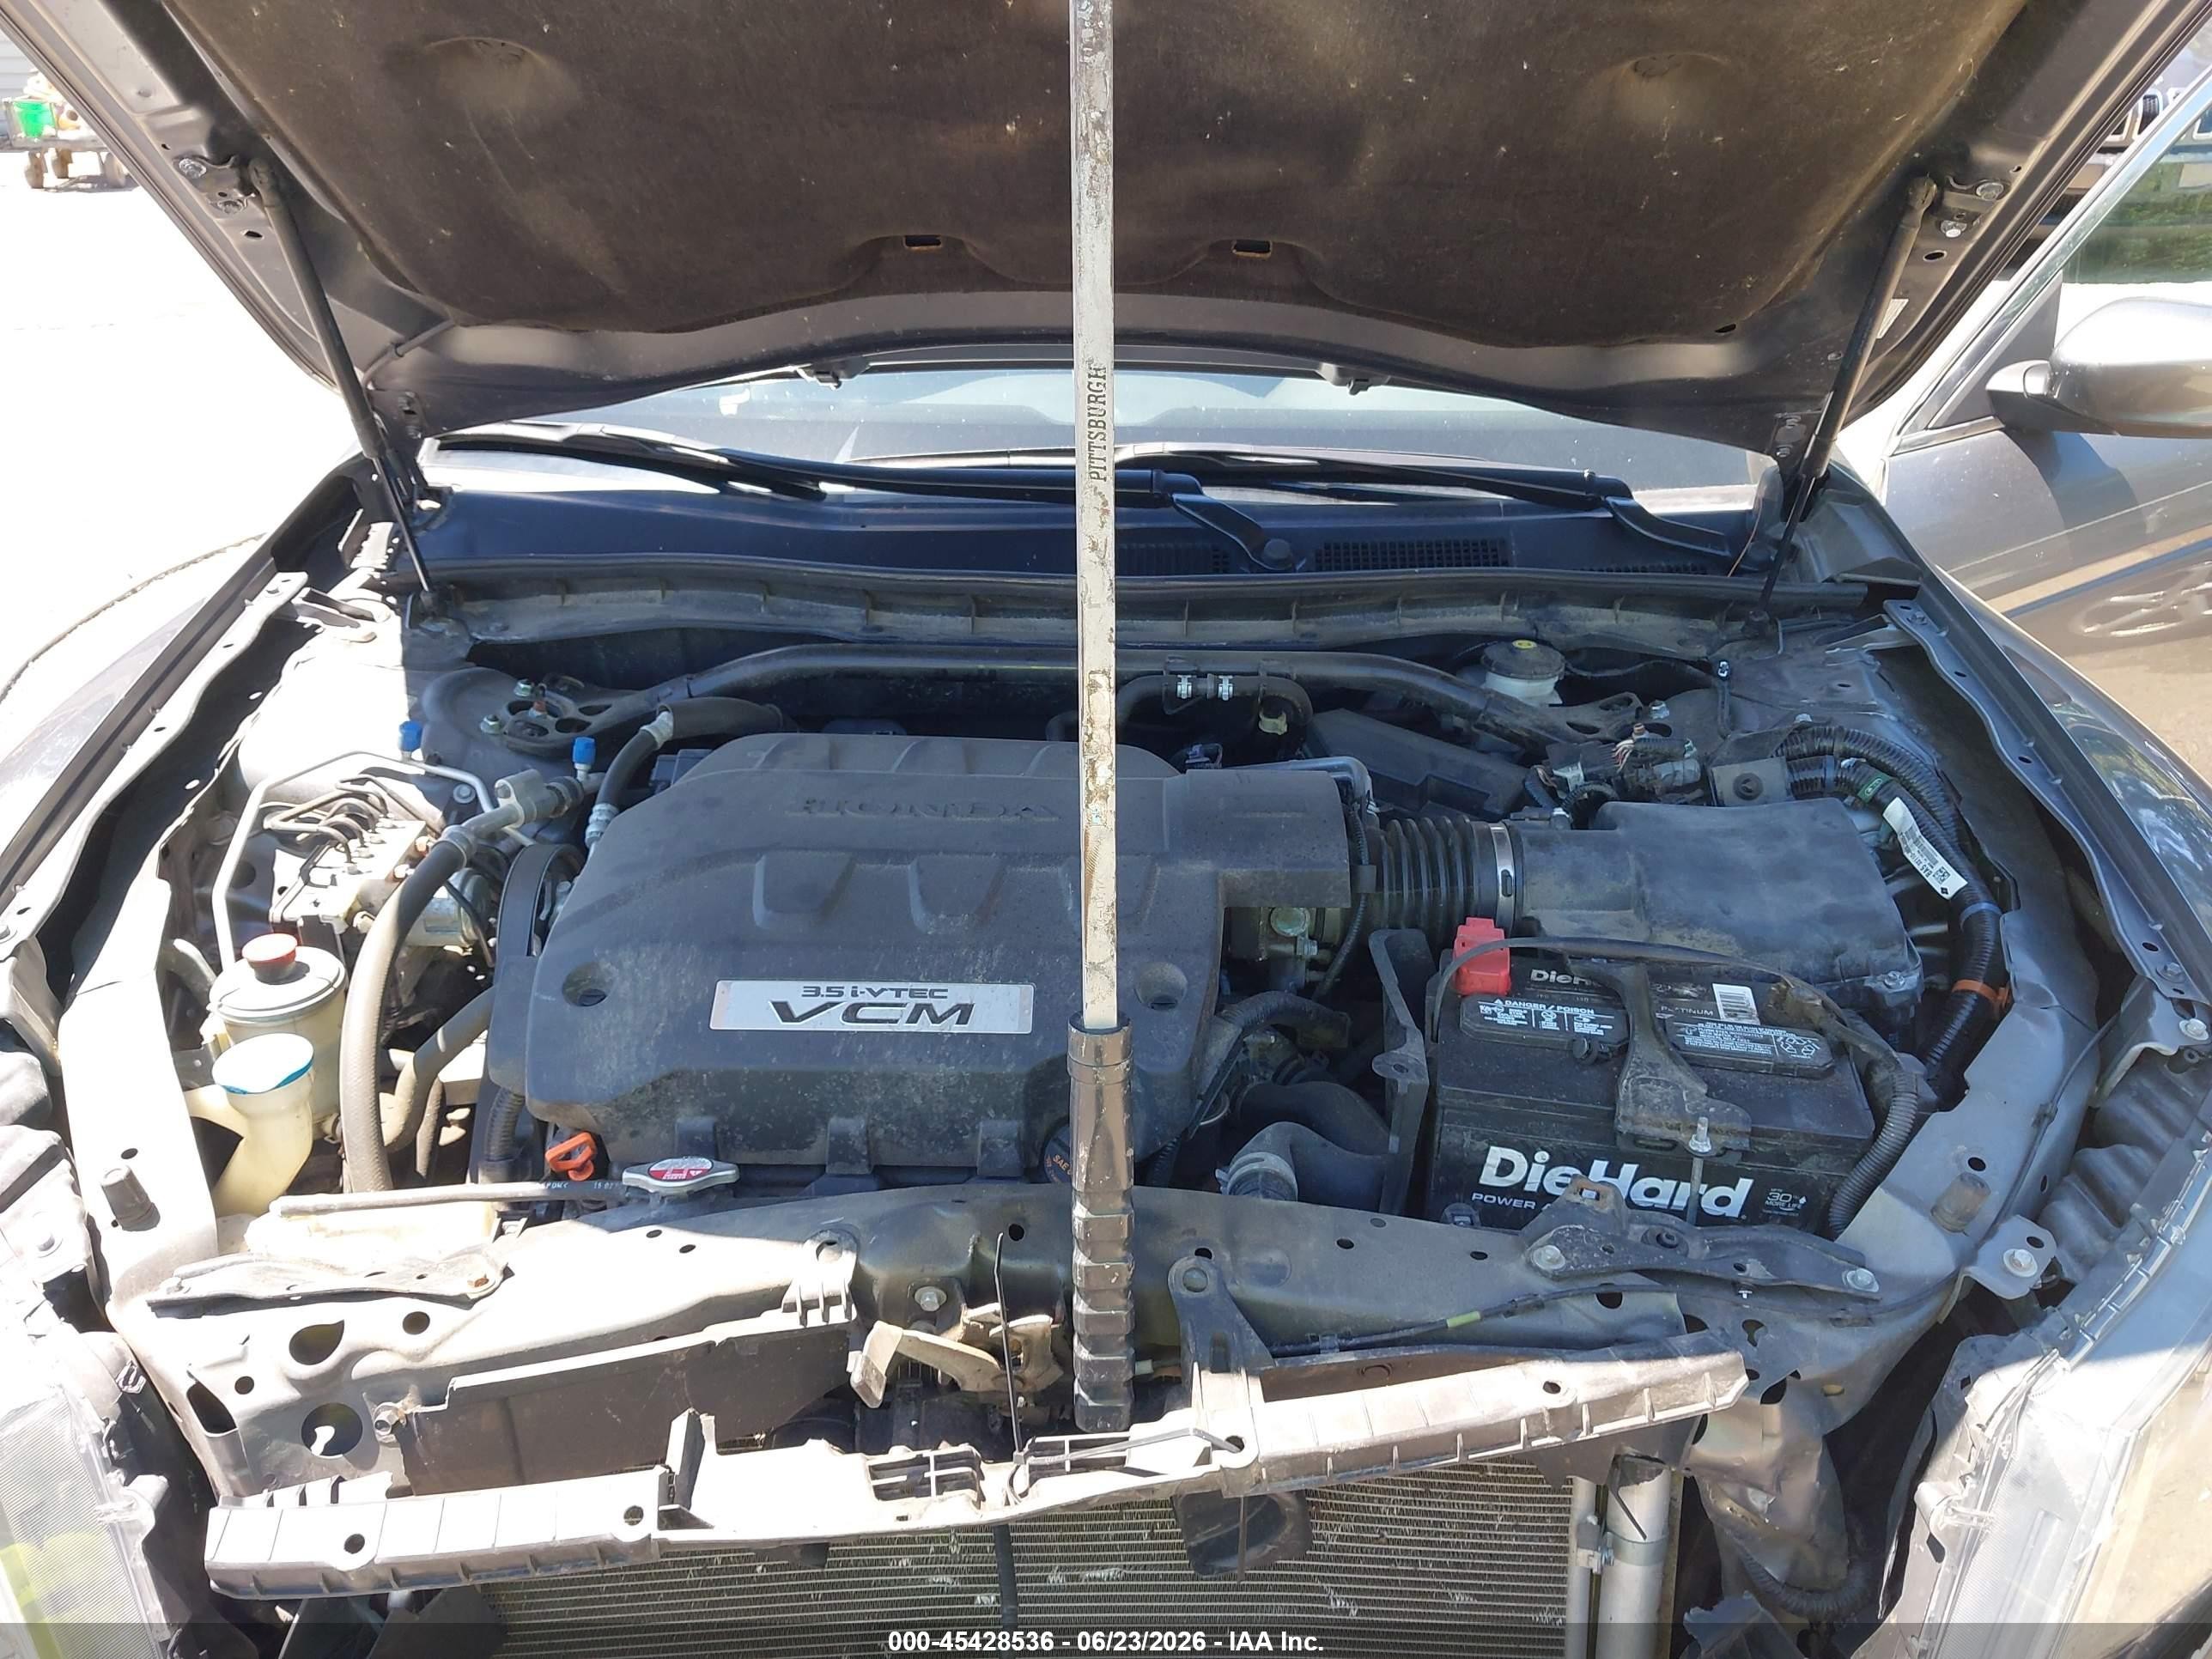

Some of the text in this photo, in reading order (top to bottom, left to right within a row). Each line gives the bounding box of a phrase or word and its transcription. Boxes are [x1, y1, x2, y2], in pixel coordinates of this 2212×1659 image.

[1087, 367, 1107, 482] PITTSBURGH
[801, 985, 949, 999] 3.5 i-VTEC
[769, 1000, 975, 1026] VCM
[1504, 1000, 1546, 1010] DANGER
[1557, 1006, 1595, 1015] POISON
[1053, 1153, 1069, 1171] SAE
[1471, 1192, 1536, 1210] POWER
